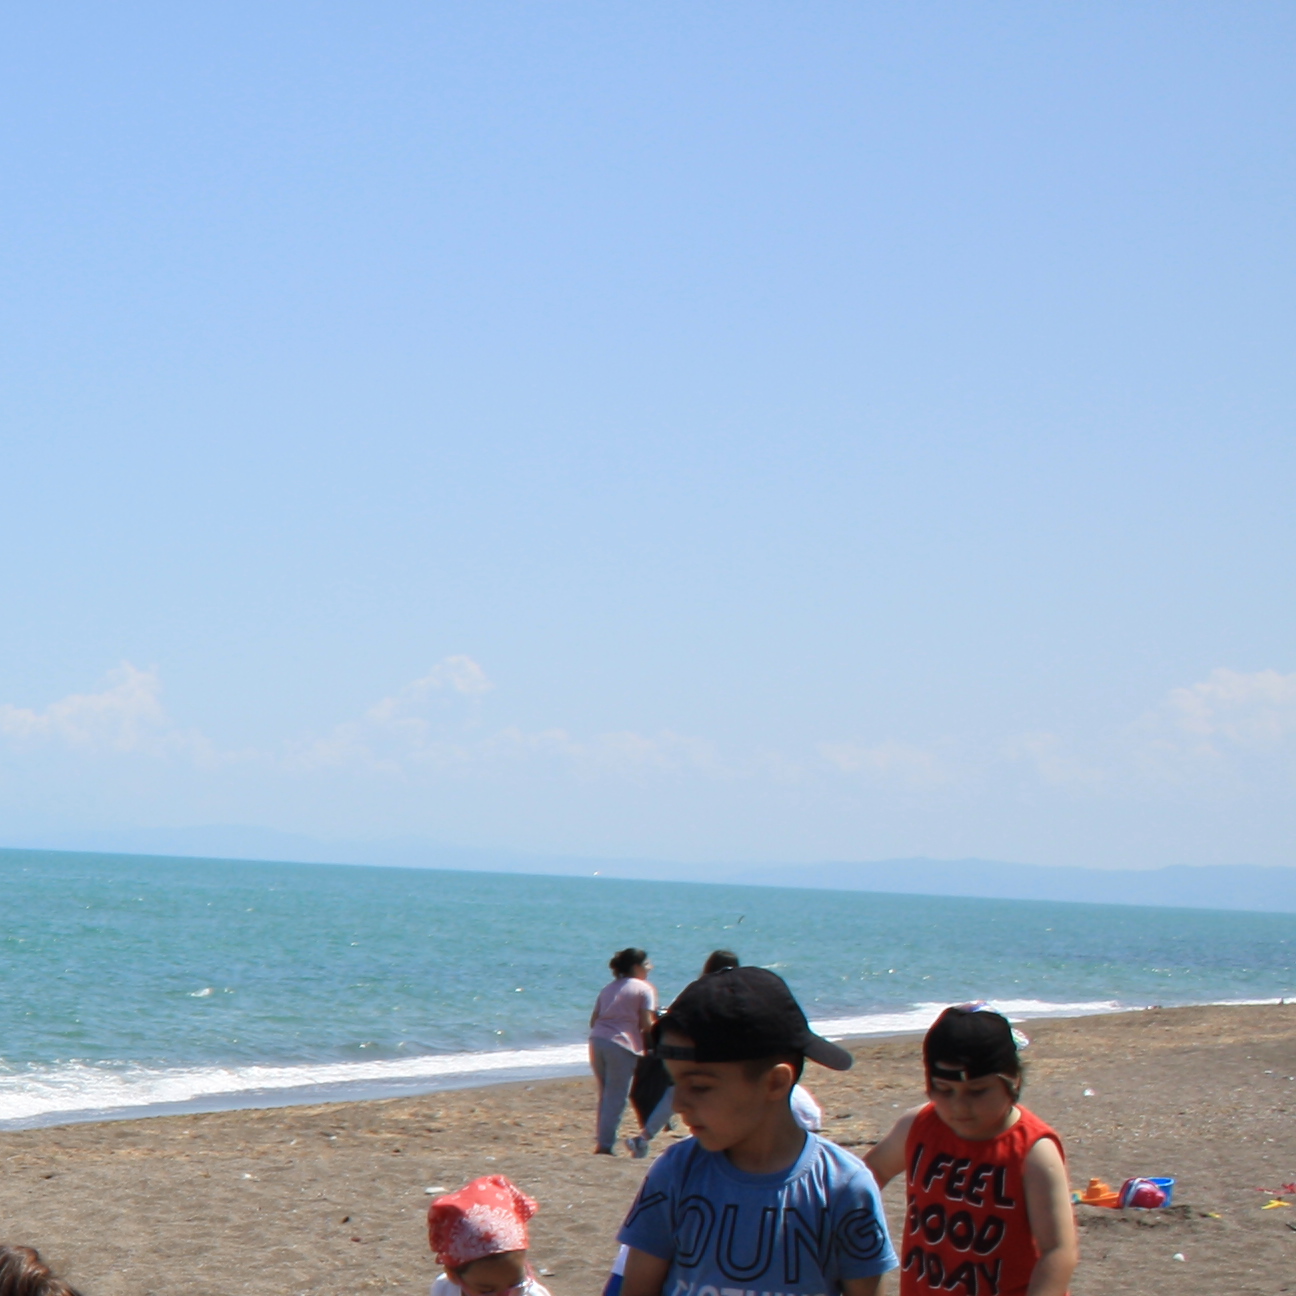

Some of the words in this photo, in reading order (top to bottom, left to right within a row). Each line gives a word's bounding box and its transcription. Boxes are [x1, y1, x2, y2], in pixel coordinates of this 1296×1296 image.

[909, 1143, 925, 1187] I
[922, 1153, 1016, 1210] FEEL
[625, 1176, 886, 1284] YOUNG
